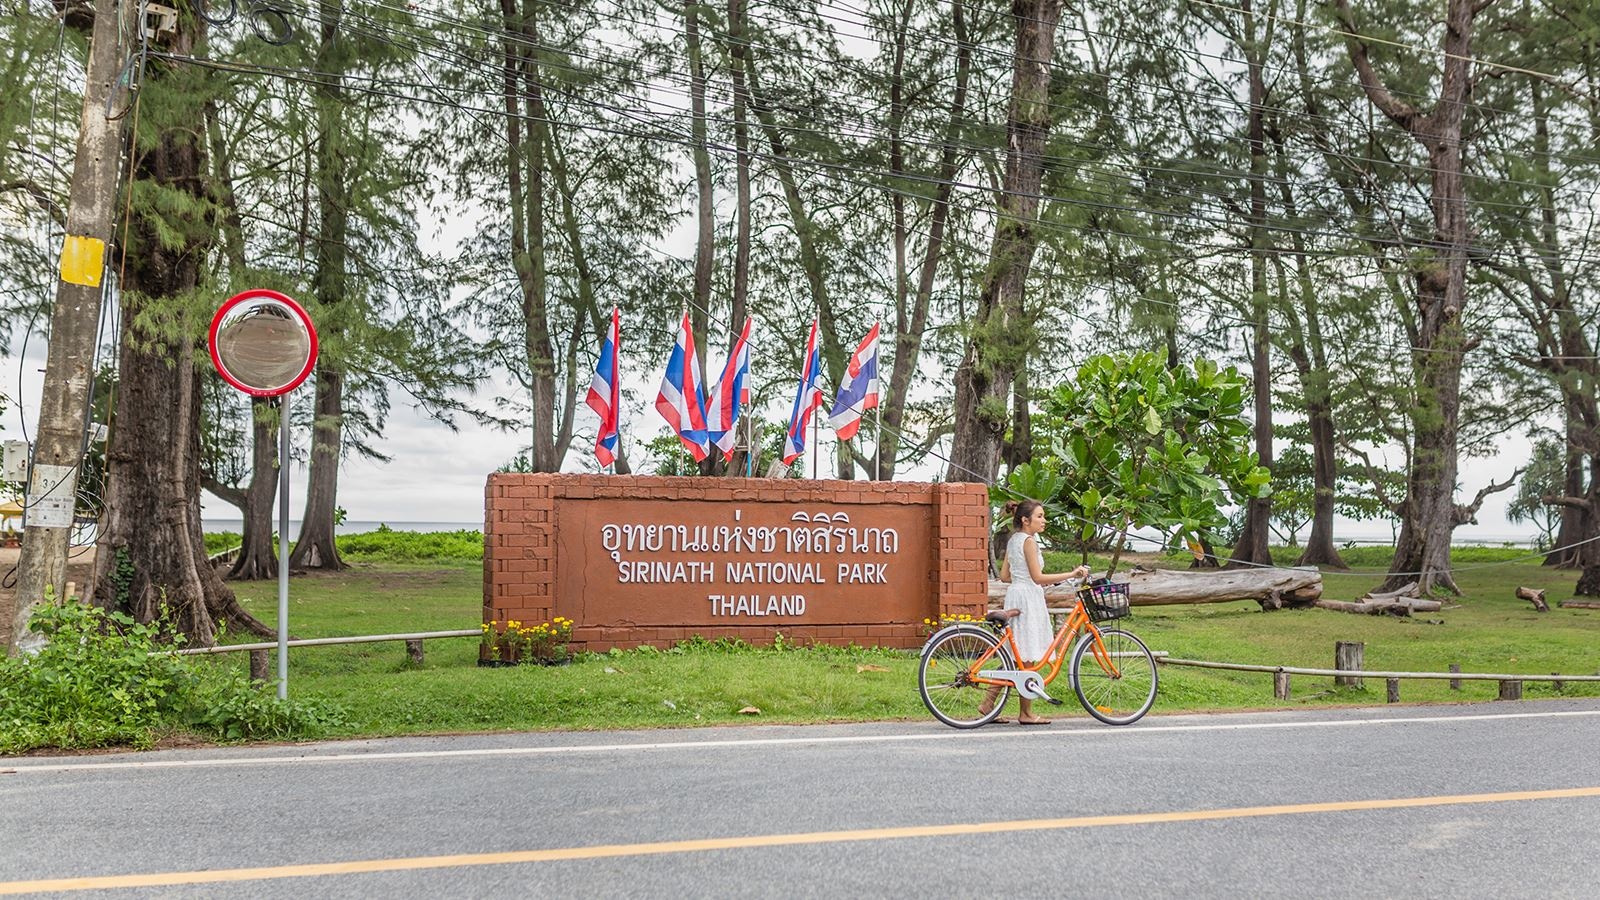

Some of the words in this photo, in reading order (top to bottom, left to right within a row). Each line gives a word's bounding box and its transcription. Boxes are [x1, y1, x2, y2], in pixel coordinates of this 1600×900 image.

[601, 509, 899, 563] อุทยานแห่งชาติสิรินาถ
[618, 560, 715, 584] SIRINATH
[726, 561, 827, 585] NATIONAL
[837, 562, 889, 584] PARK
[708, 594, 807, 616] THAILAND
